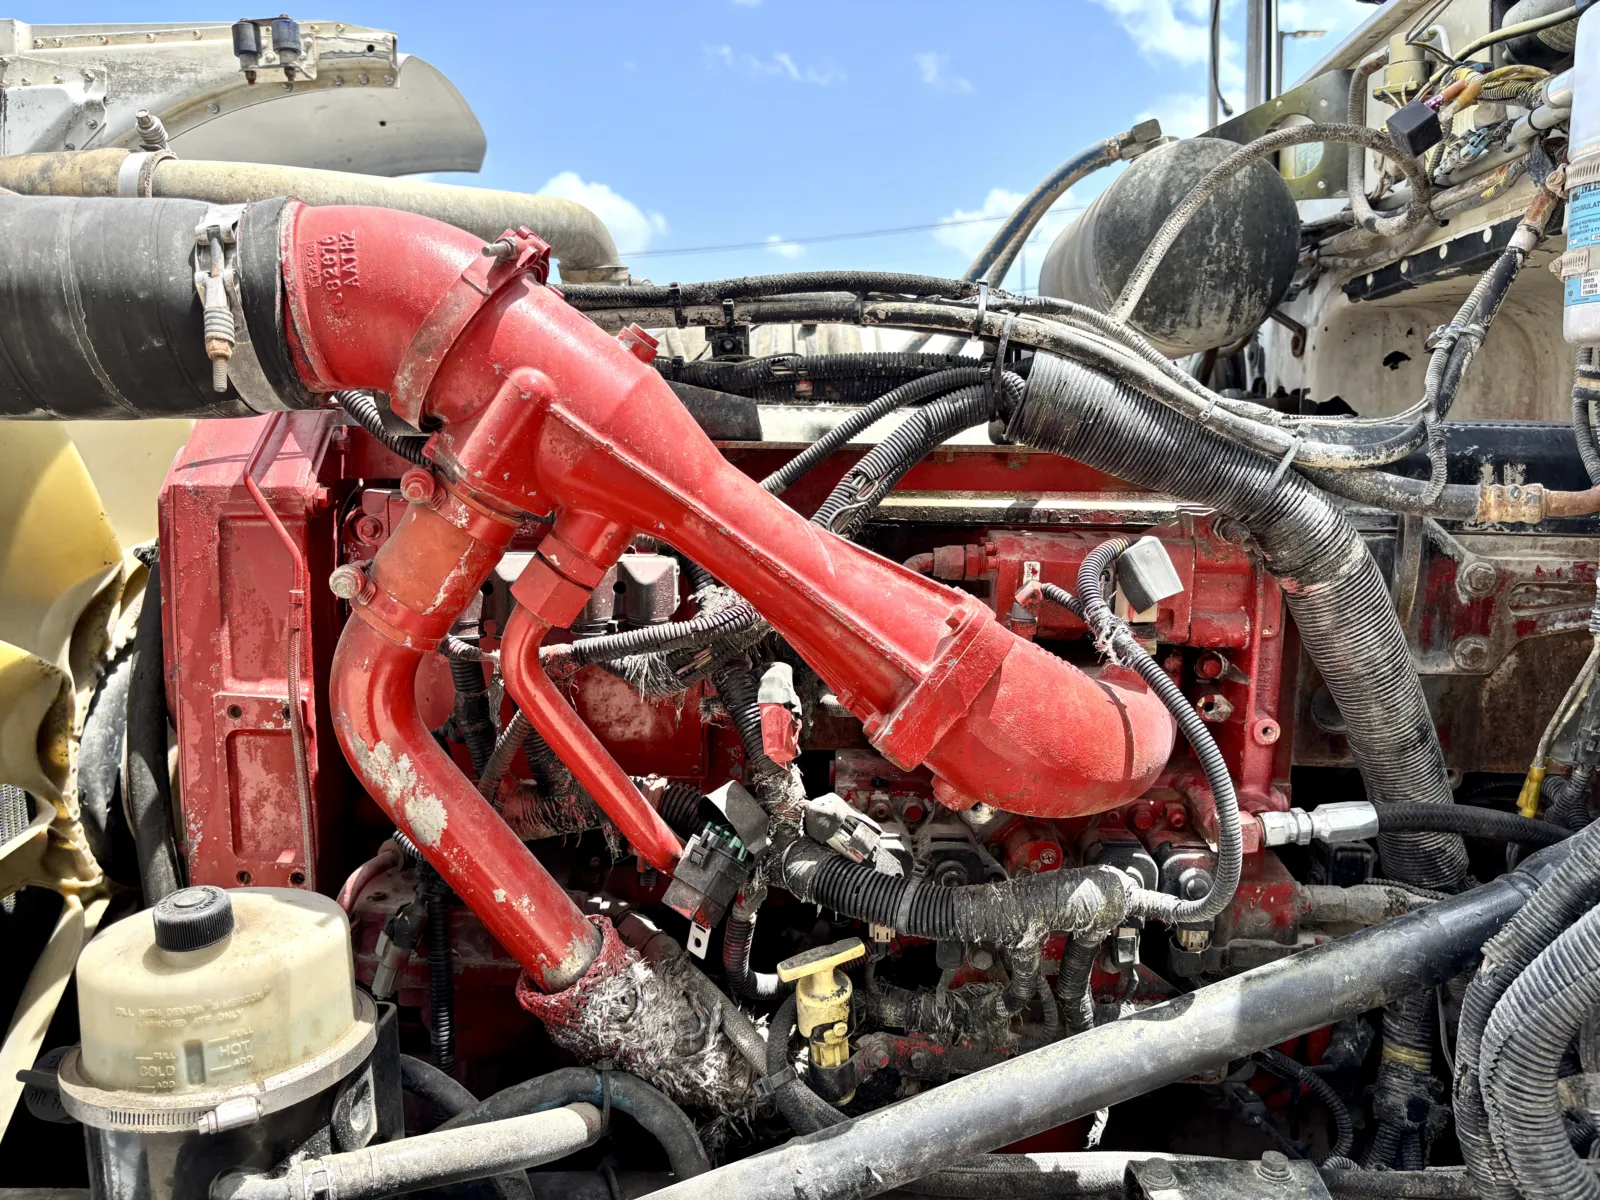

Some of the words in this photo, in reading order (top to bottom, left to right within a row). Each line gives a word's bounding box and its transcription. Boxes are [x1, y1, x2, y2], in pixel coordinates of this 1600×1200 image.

[193, 1014, 212, 1025] ATF
[217, 1007, 244, 1021] ONLY
[230, 1026, 254, 1037] FULL
[219, 1040, 250, 1058] HOT
[153, 1051, 177, 1060] FULL
[233, 1055, 254, 1066] ADD
[139, 1065, 176, 1077] COLD
[157, 1080, 176, 1089] ADD
